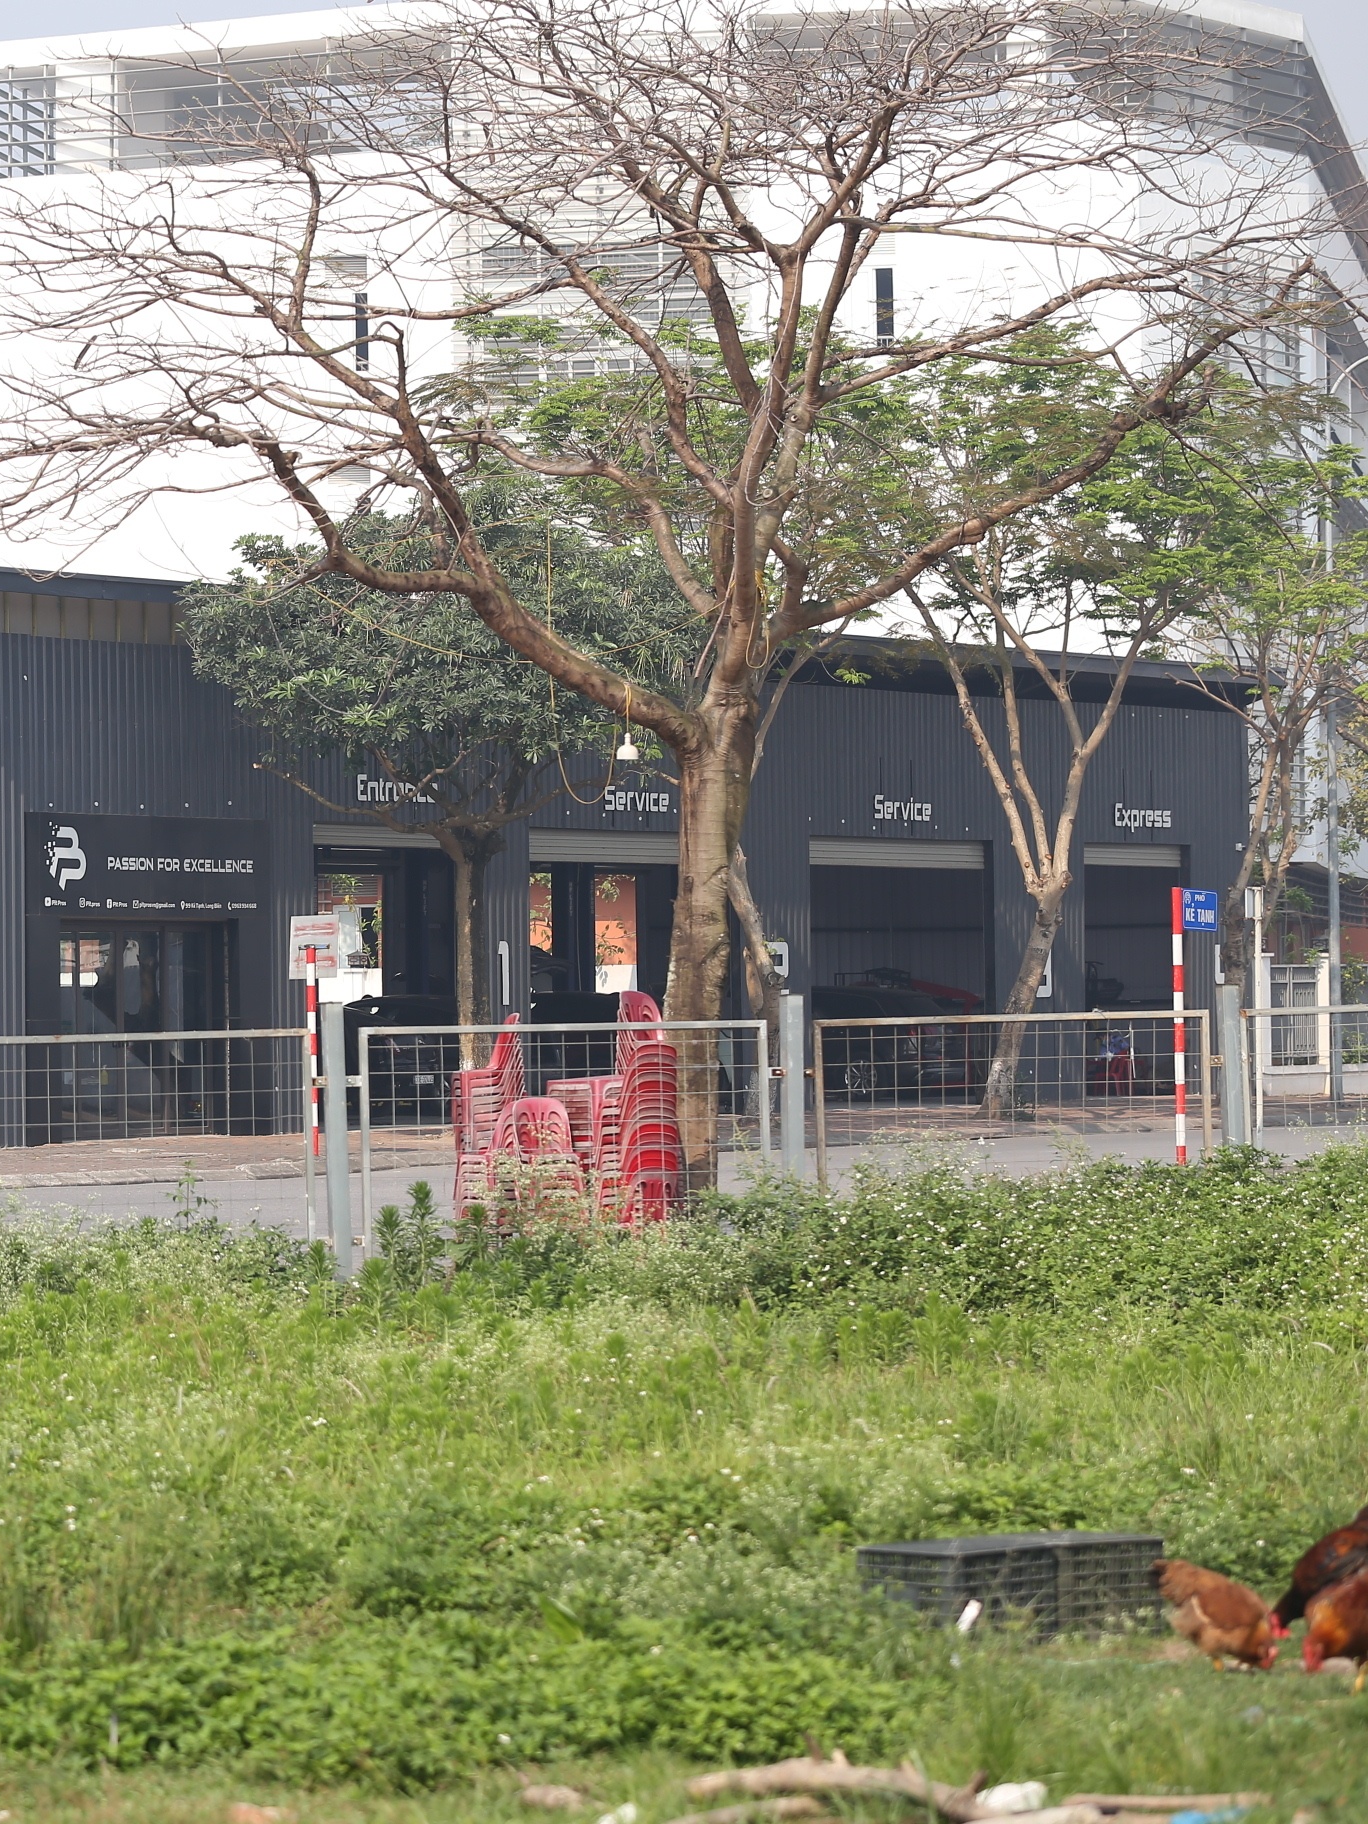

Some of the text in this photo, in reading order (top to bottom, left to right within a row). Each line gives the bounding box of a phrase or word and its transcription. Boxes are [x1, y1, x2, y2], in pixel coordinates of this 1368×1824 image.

[605, 785, 670, 812] Service
[874, 794, 932, 821] Service
[1114, 802, 1172, 833] Express
[107, 856, 254, 873] PASSION FOR EXCELLENCE
[1194, 892, 1206, 902] PHỐ
[1185, 902, 1215, 926] KẺ TẠNH
[498, 941, 510, 1005] 1
